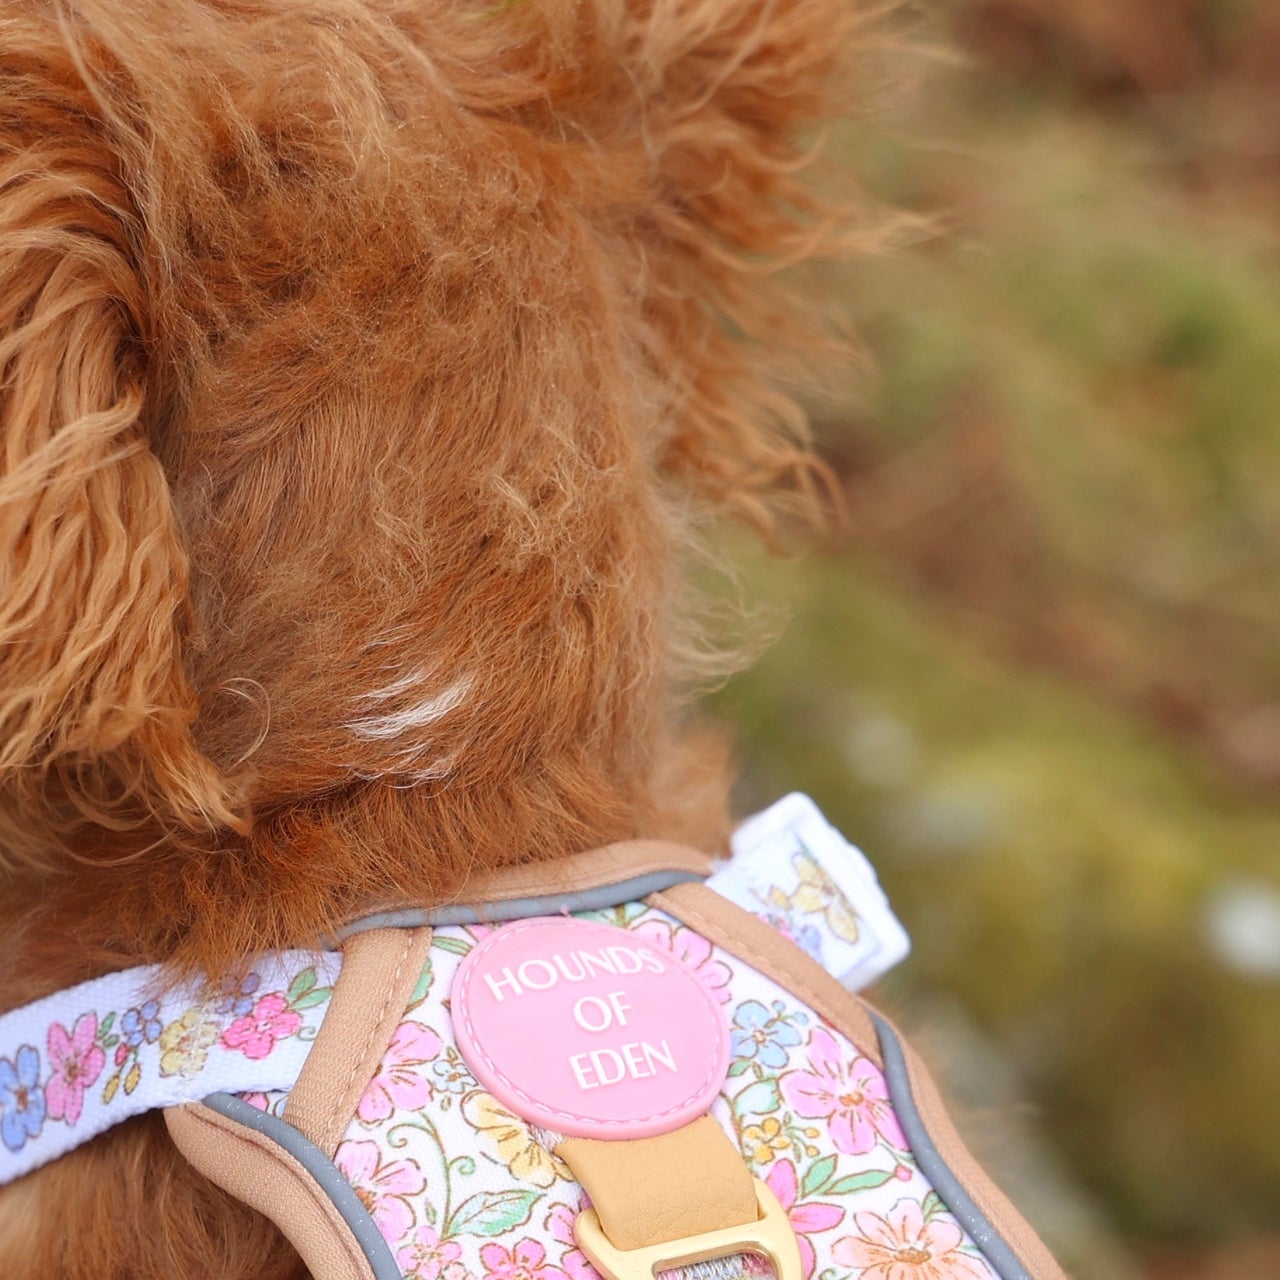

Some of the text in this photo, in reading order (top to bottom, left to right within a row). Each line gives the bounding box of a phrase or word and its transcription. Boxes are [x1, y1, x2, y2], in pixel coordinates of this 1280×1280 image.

[484, 946, 666, 1002] HOUNDS
[573, 992, 631, 1032] OF
[569, 1040, 678, 1090] EDEN
